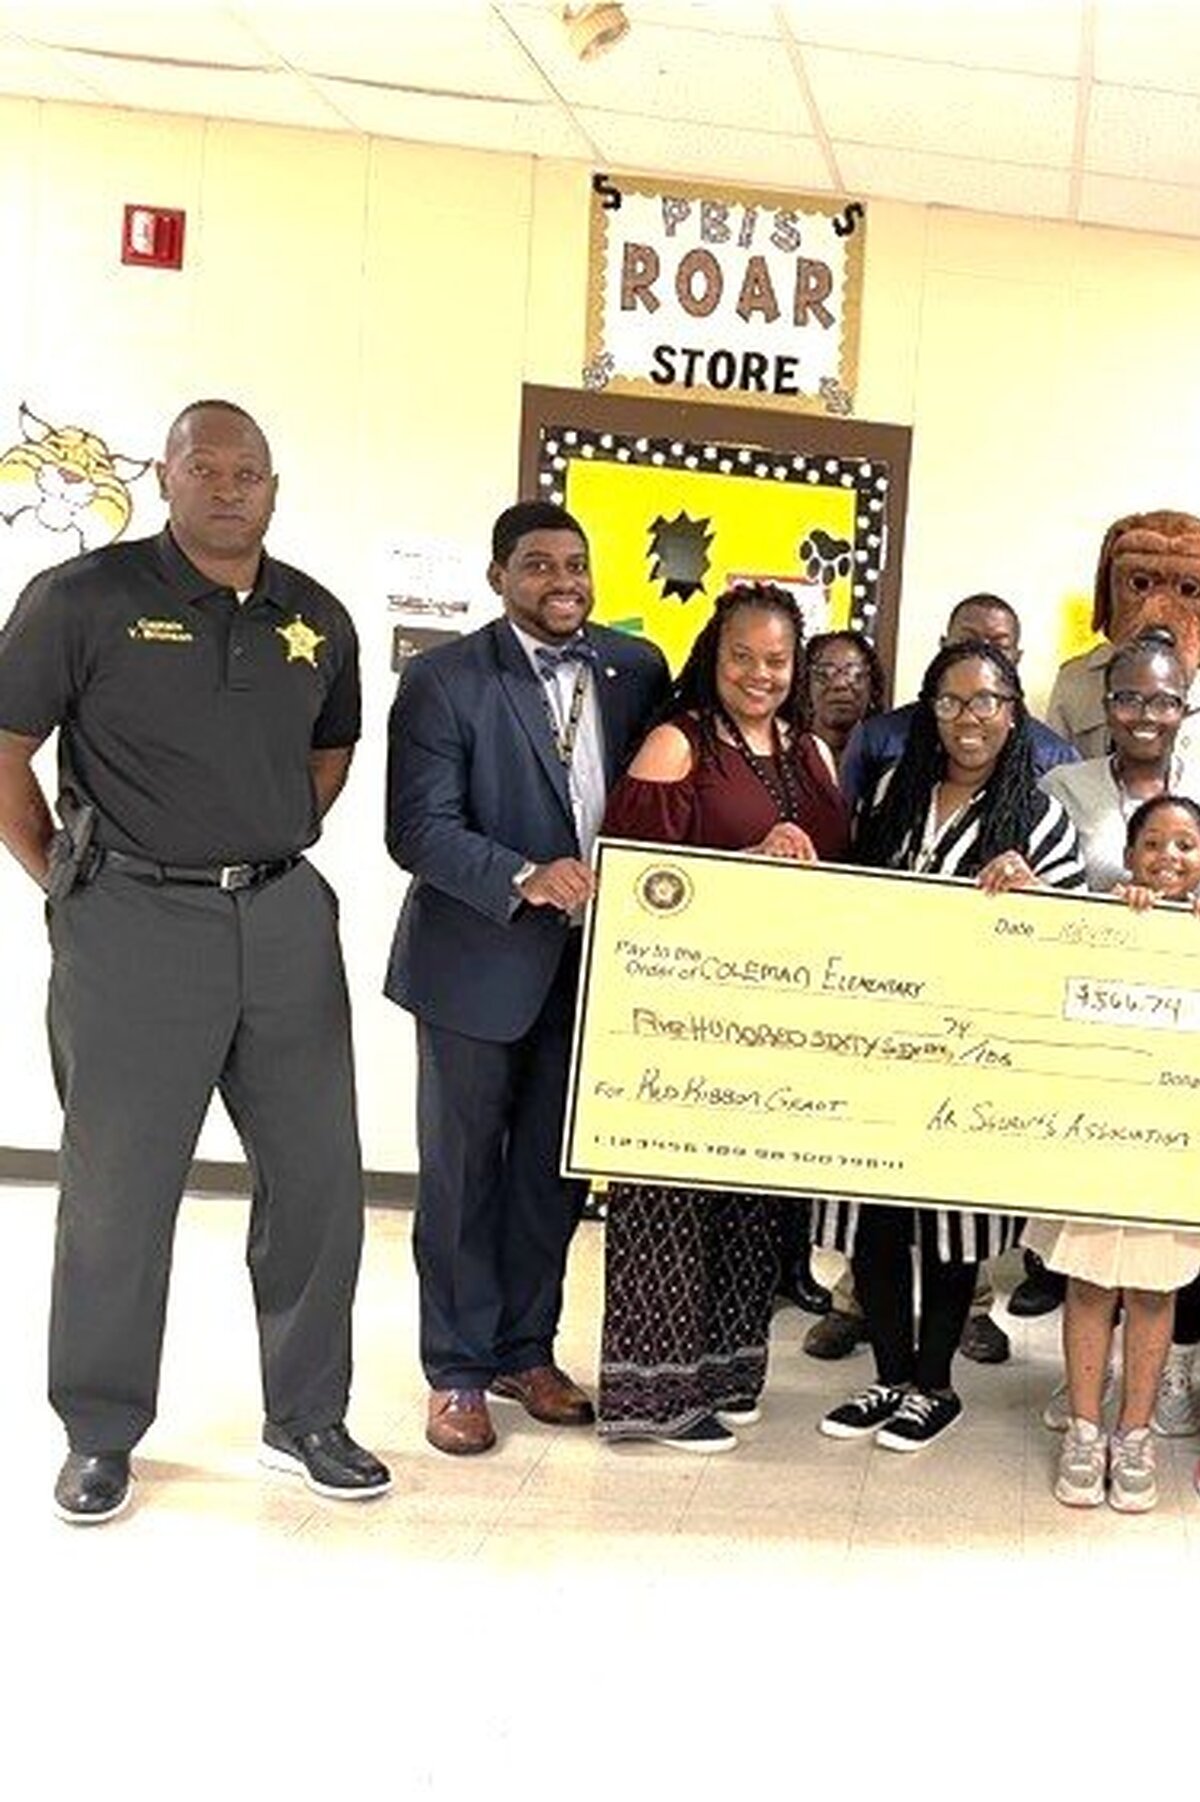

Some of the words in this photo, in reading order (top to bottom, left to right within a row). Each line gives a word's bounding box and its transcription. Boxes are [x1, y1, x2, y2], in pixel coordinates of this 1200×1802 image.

[661, 197, 802, 252] PBIS
[620, 241, 836, 330] ROAR
[649, 345, 801, 396] STORE
[994, 918, 1034, 938] Date
[625, 959, 676, 977] Order
[678, 966, 699, 980] of
[594, 1080, 625, 1099] For
